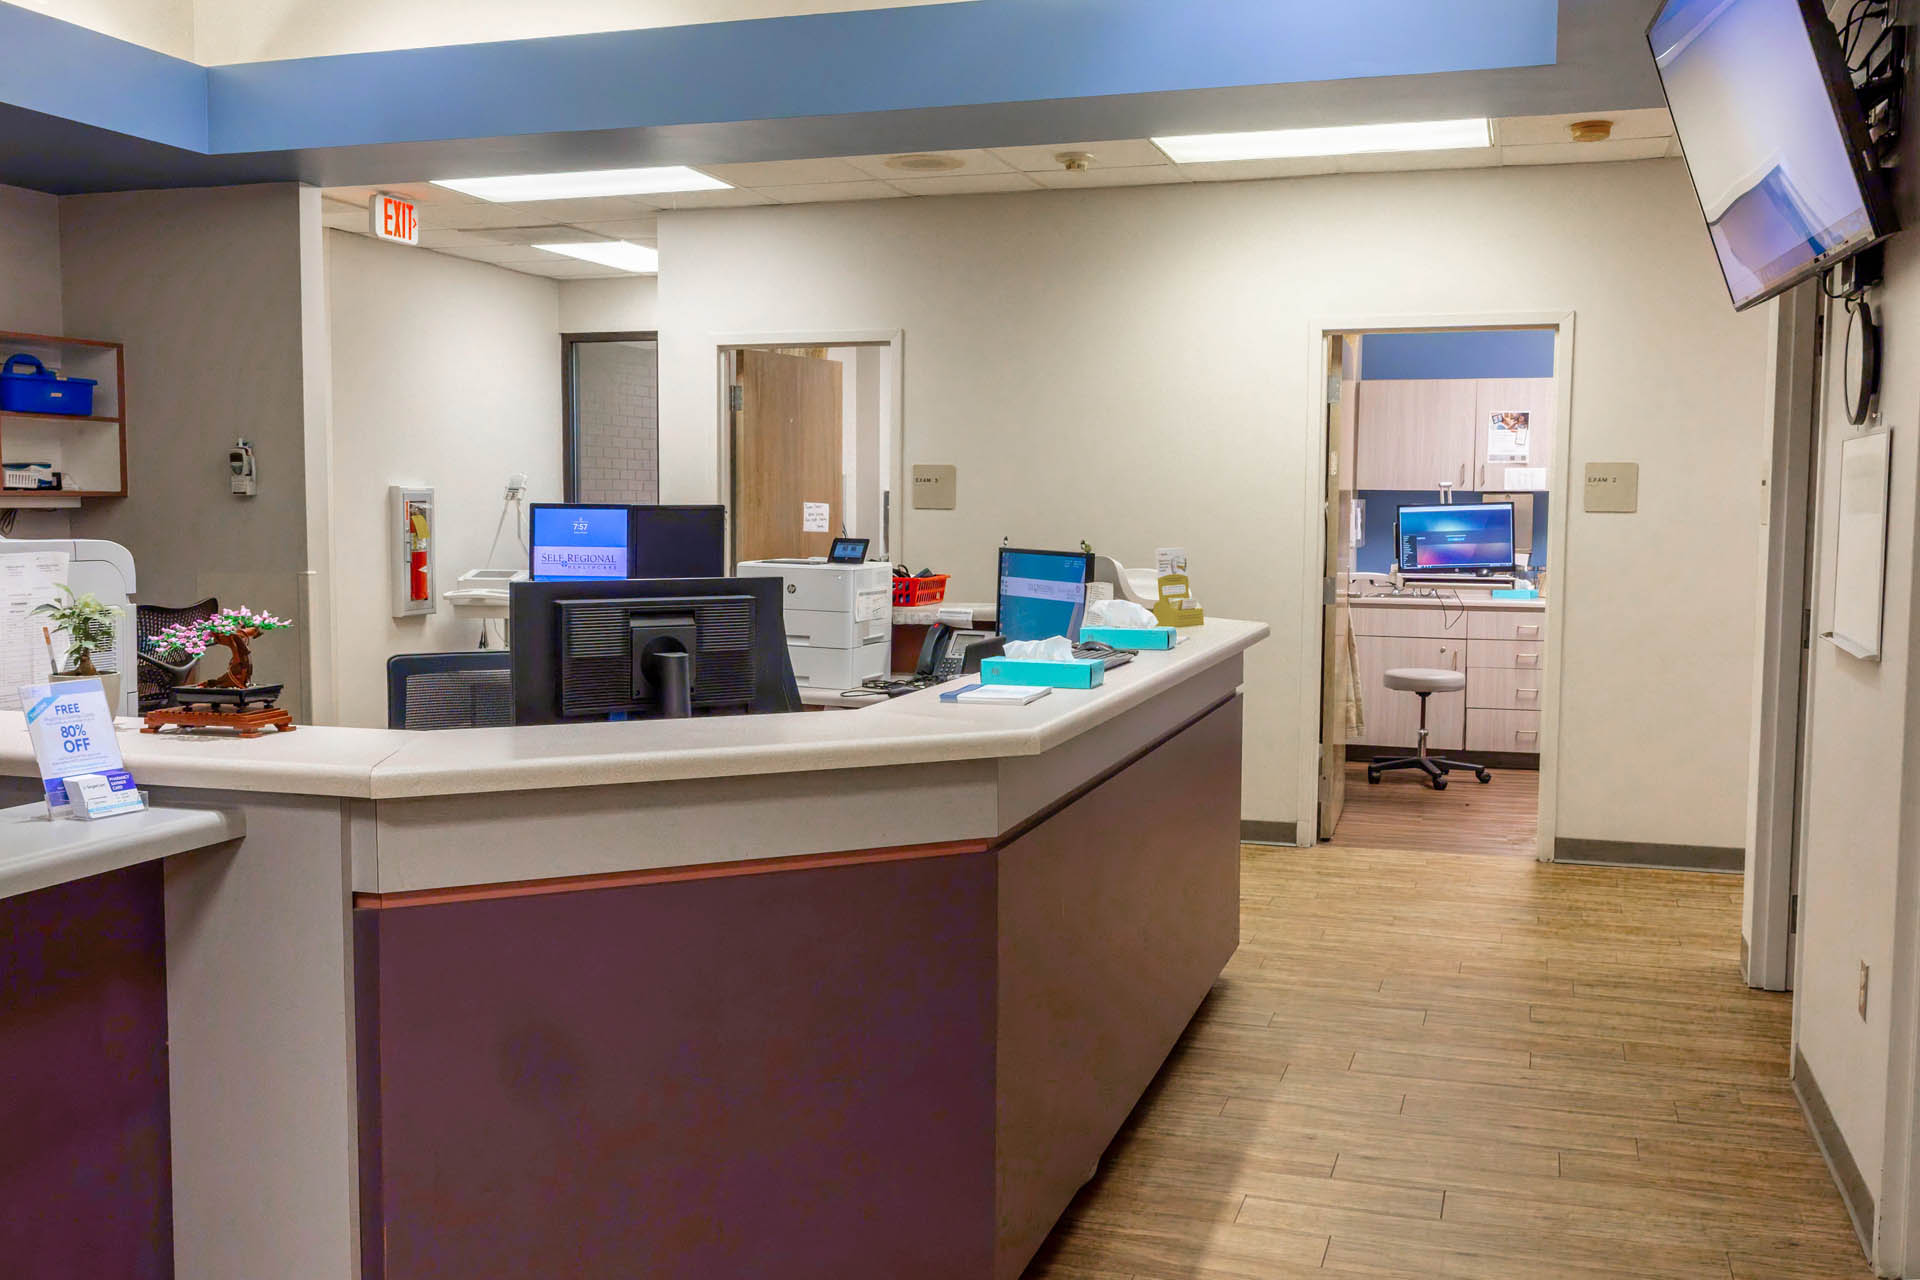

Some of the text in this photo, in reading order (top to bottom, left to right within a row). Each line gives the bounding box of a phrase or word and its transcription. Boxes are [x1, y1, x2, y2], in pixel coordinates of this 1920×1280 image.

[384, 197, 414, 240] EXIT
[573, 523, 588, 531] 7:57
[567, 553, 616, 563] REGIONAL
[55, 703, 80, 715] FREE
[60, 723, 86, 739] 80%
[63, 737, 90, 753] OFF
